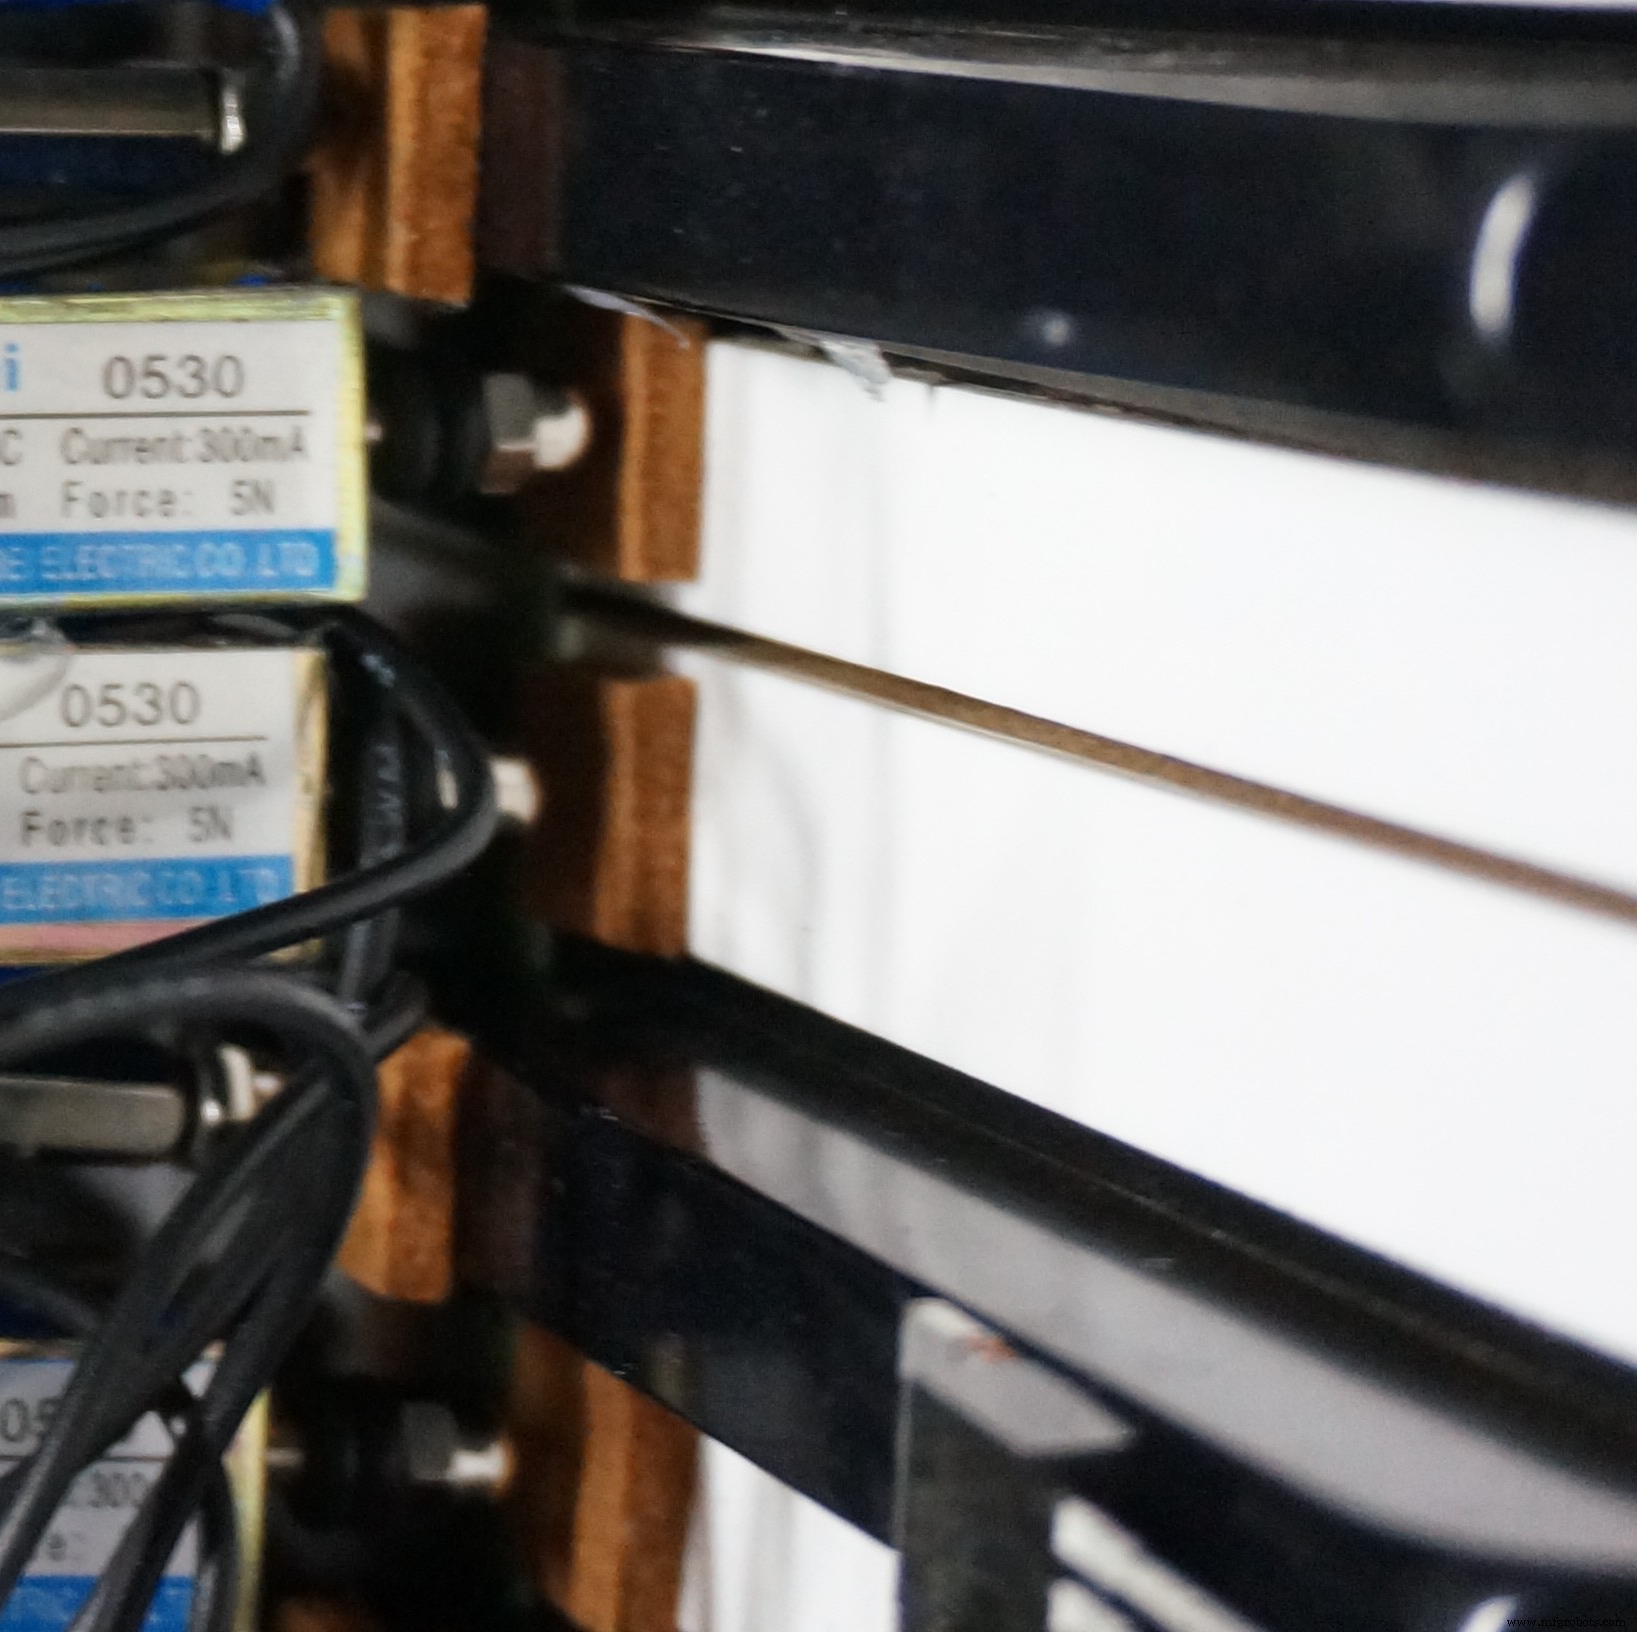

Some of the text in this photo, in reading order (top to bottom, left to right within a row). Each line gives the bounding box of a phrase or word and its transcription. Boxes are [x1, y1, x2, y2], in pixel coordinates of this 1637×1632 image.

[101, 352, 247, 401] 0530
[60, 476, 279, 521] Force: 5N
[61, 678, 203, 730] 0530
[19, 804, 235, 850] Force: 5N
